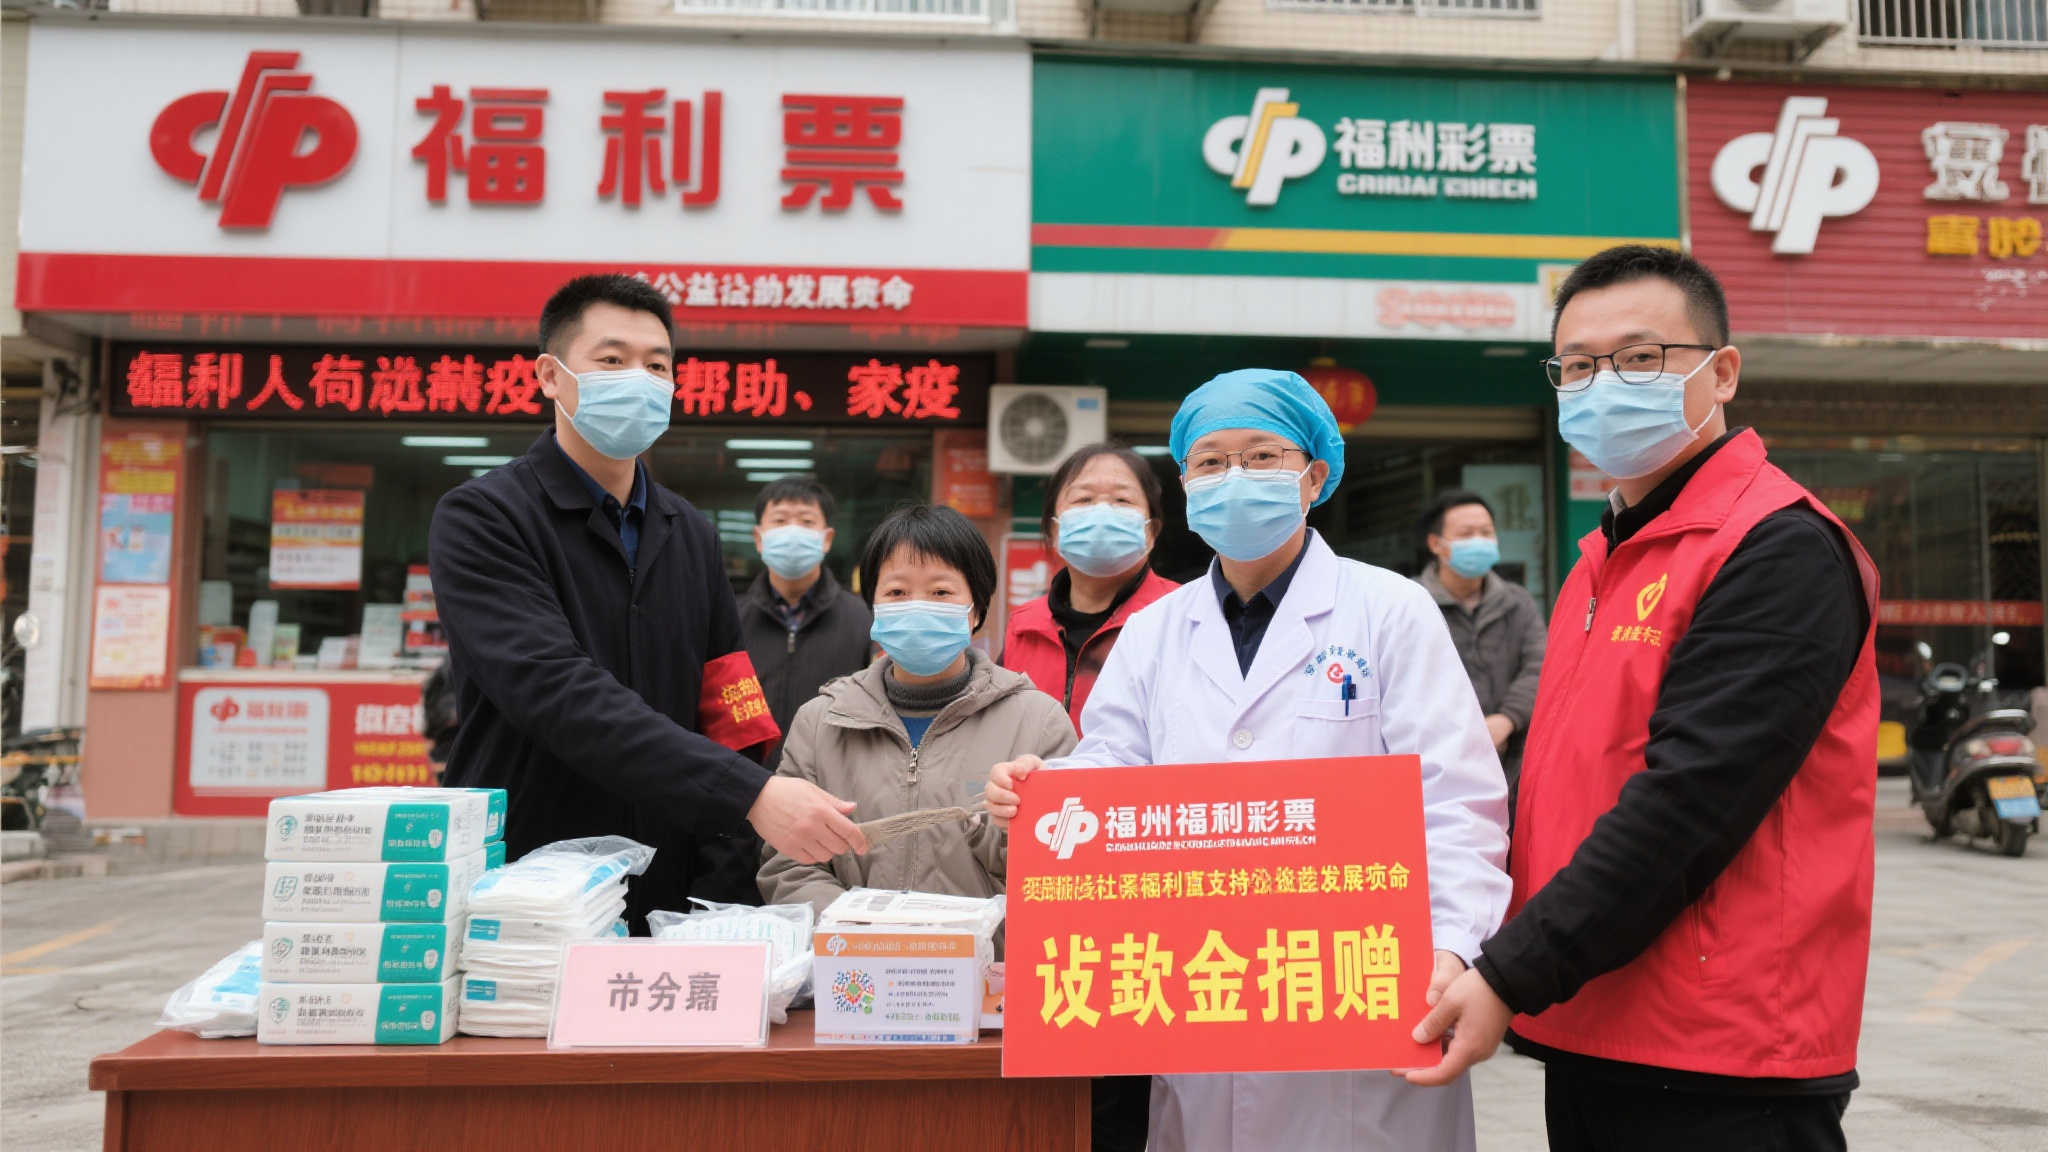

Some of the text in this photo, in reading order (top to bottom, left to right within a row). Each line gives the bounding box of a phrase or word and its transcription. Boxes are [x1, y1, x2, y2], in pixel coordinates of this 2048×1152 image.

[1104, 798, 1316, 839] 福州福利彩票
